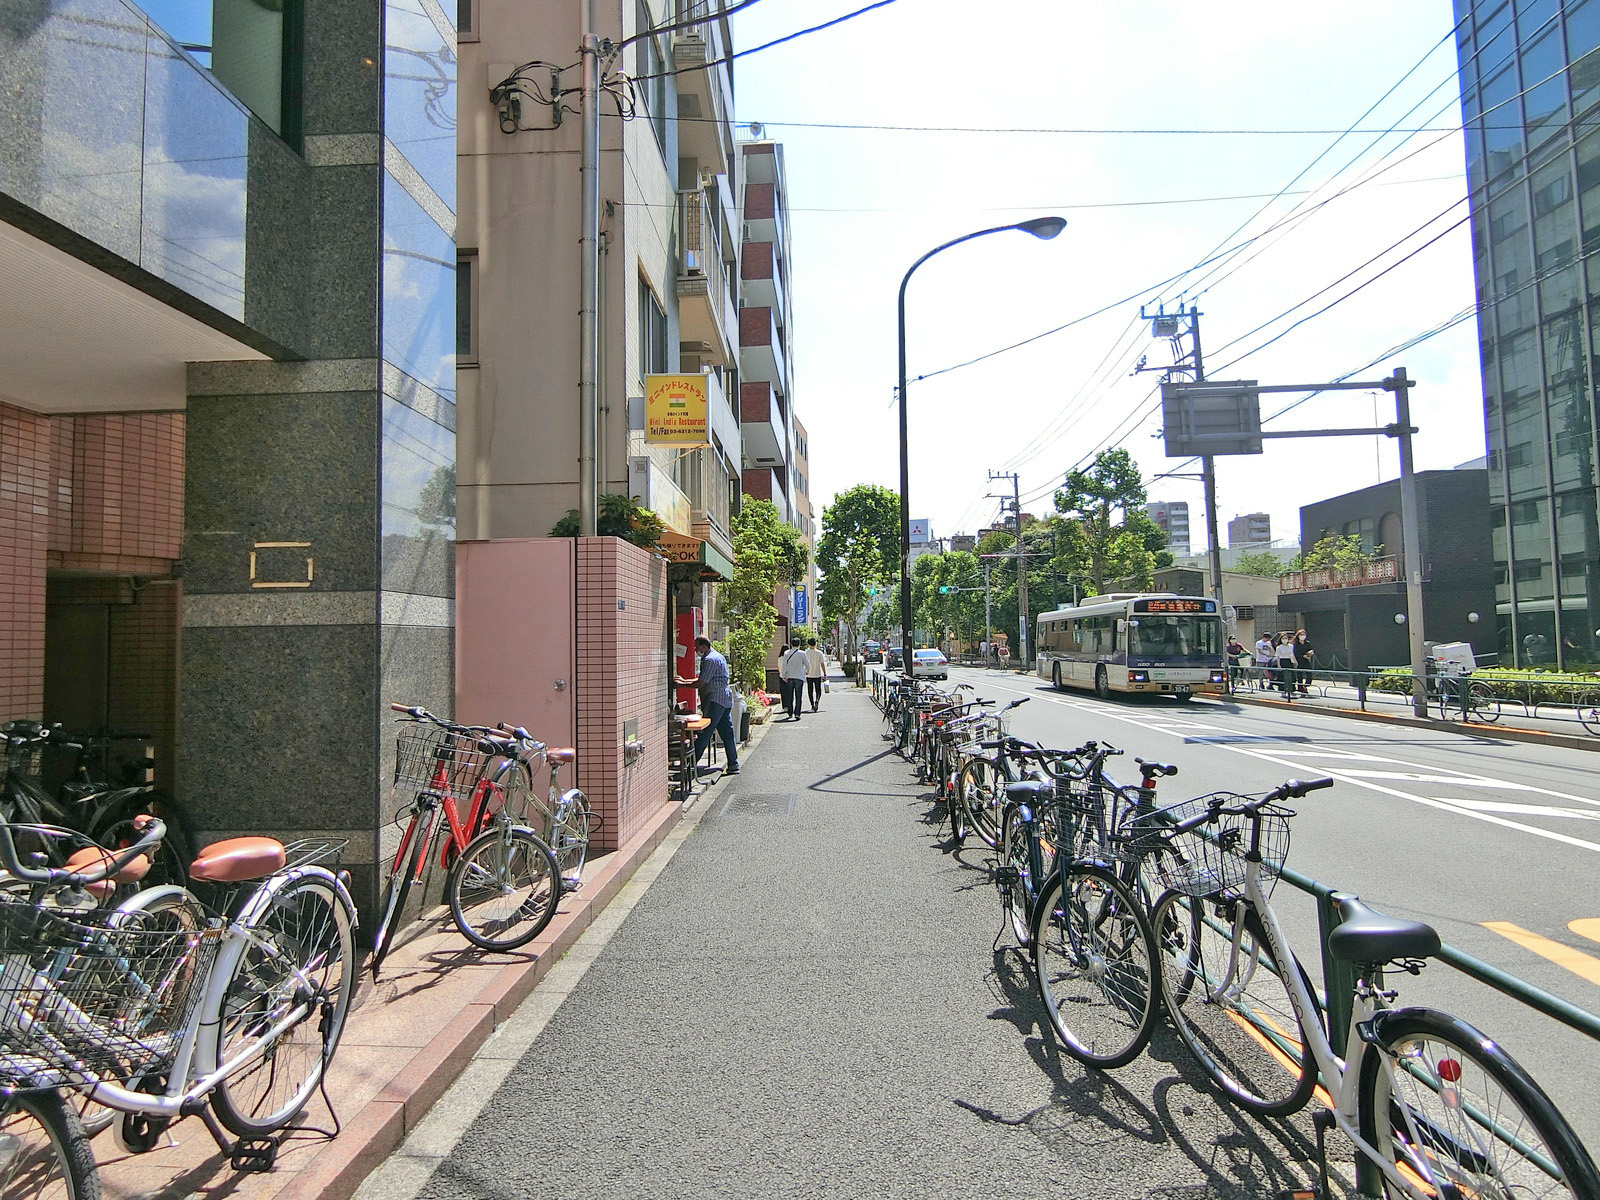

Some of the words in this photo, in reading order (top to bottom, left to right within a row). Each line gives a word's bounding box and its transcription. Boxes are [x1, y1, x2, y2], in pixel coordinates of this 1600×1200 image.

[648, 381, 706, 405] ミニインドレストラン
[663, 418, 677, 426] India
[679, 418, 706, 426] Restaurant
